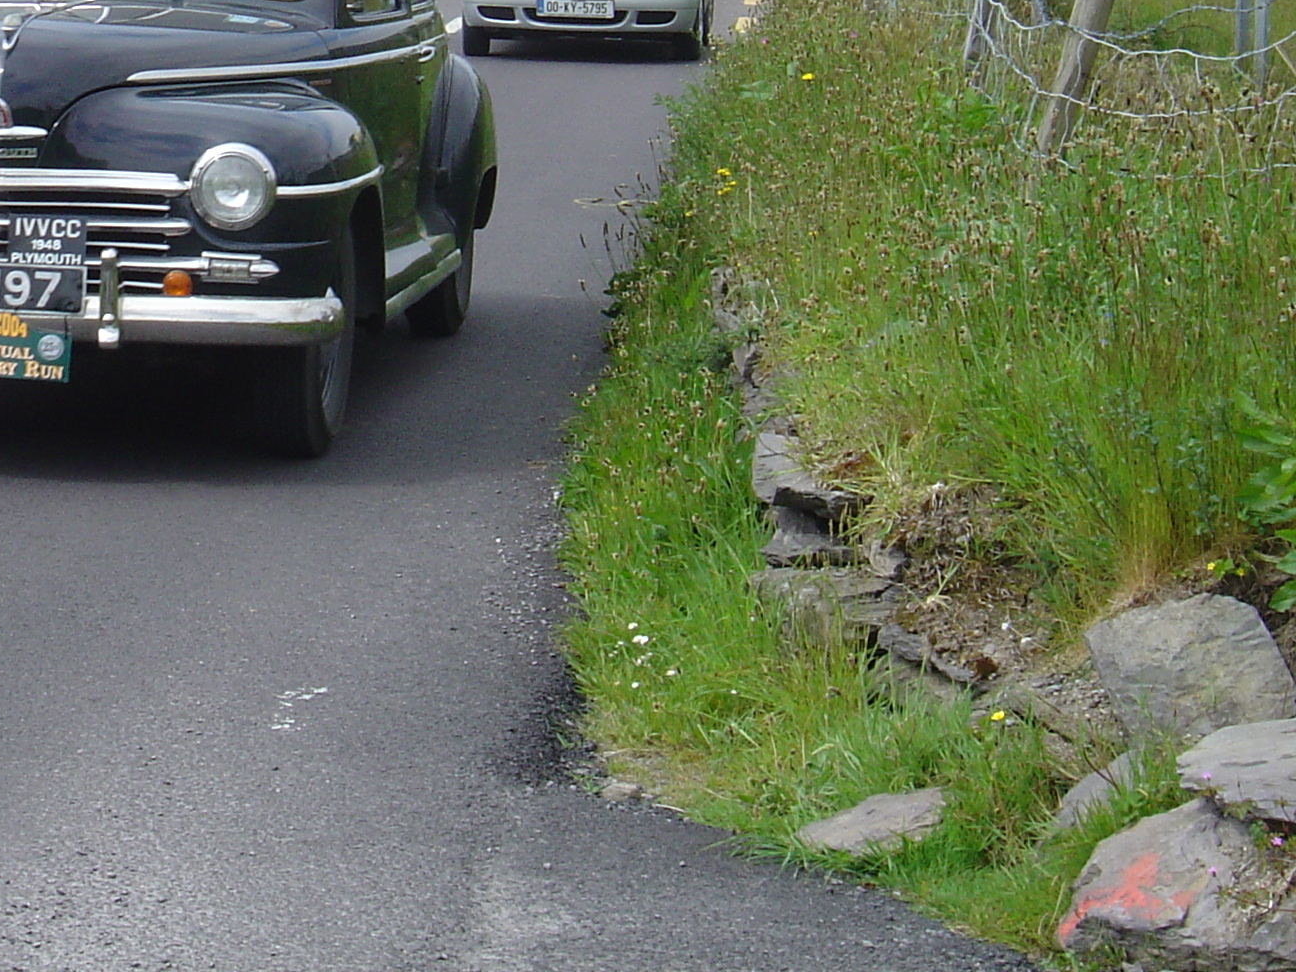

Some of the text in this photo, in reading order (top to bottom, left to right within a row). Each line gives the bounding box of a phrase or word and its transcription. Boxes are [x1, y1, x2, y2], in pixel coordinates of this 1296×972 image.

[546, 1, 608, 14] 00-KY-5795
[14, 217, 82, 239] IVVCC
[31, 239, 62, 251] 1948
[10, 251, 82, 266] PLYMOUTH
